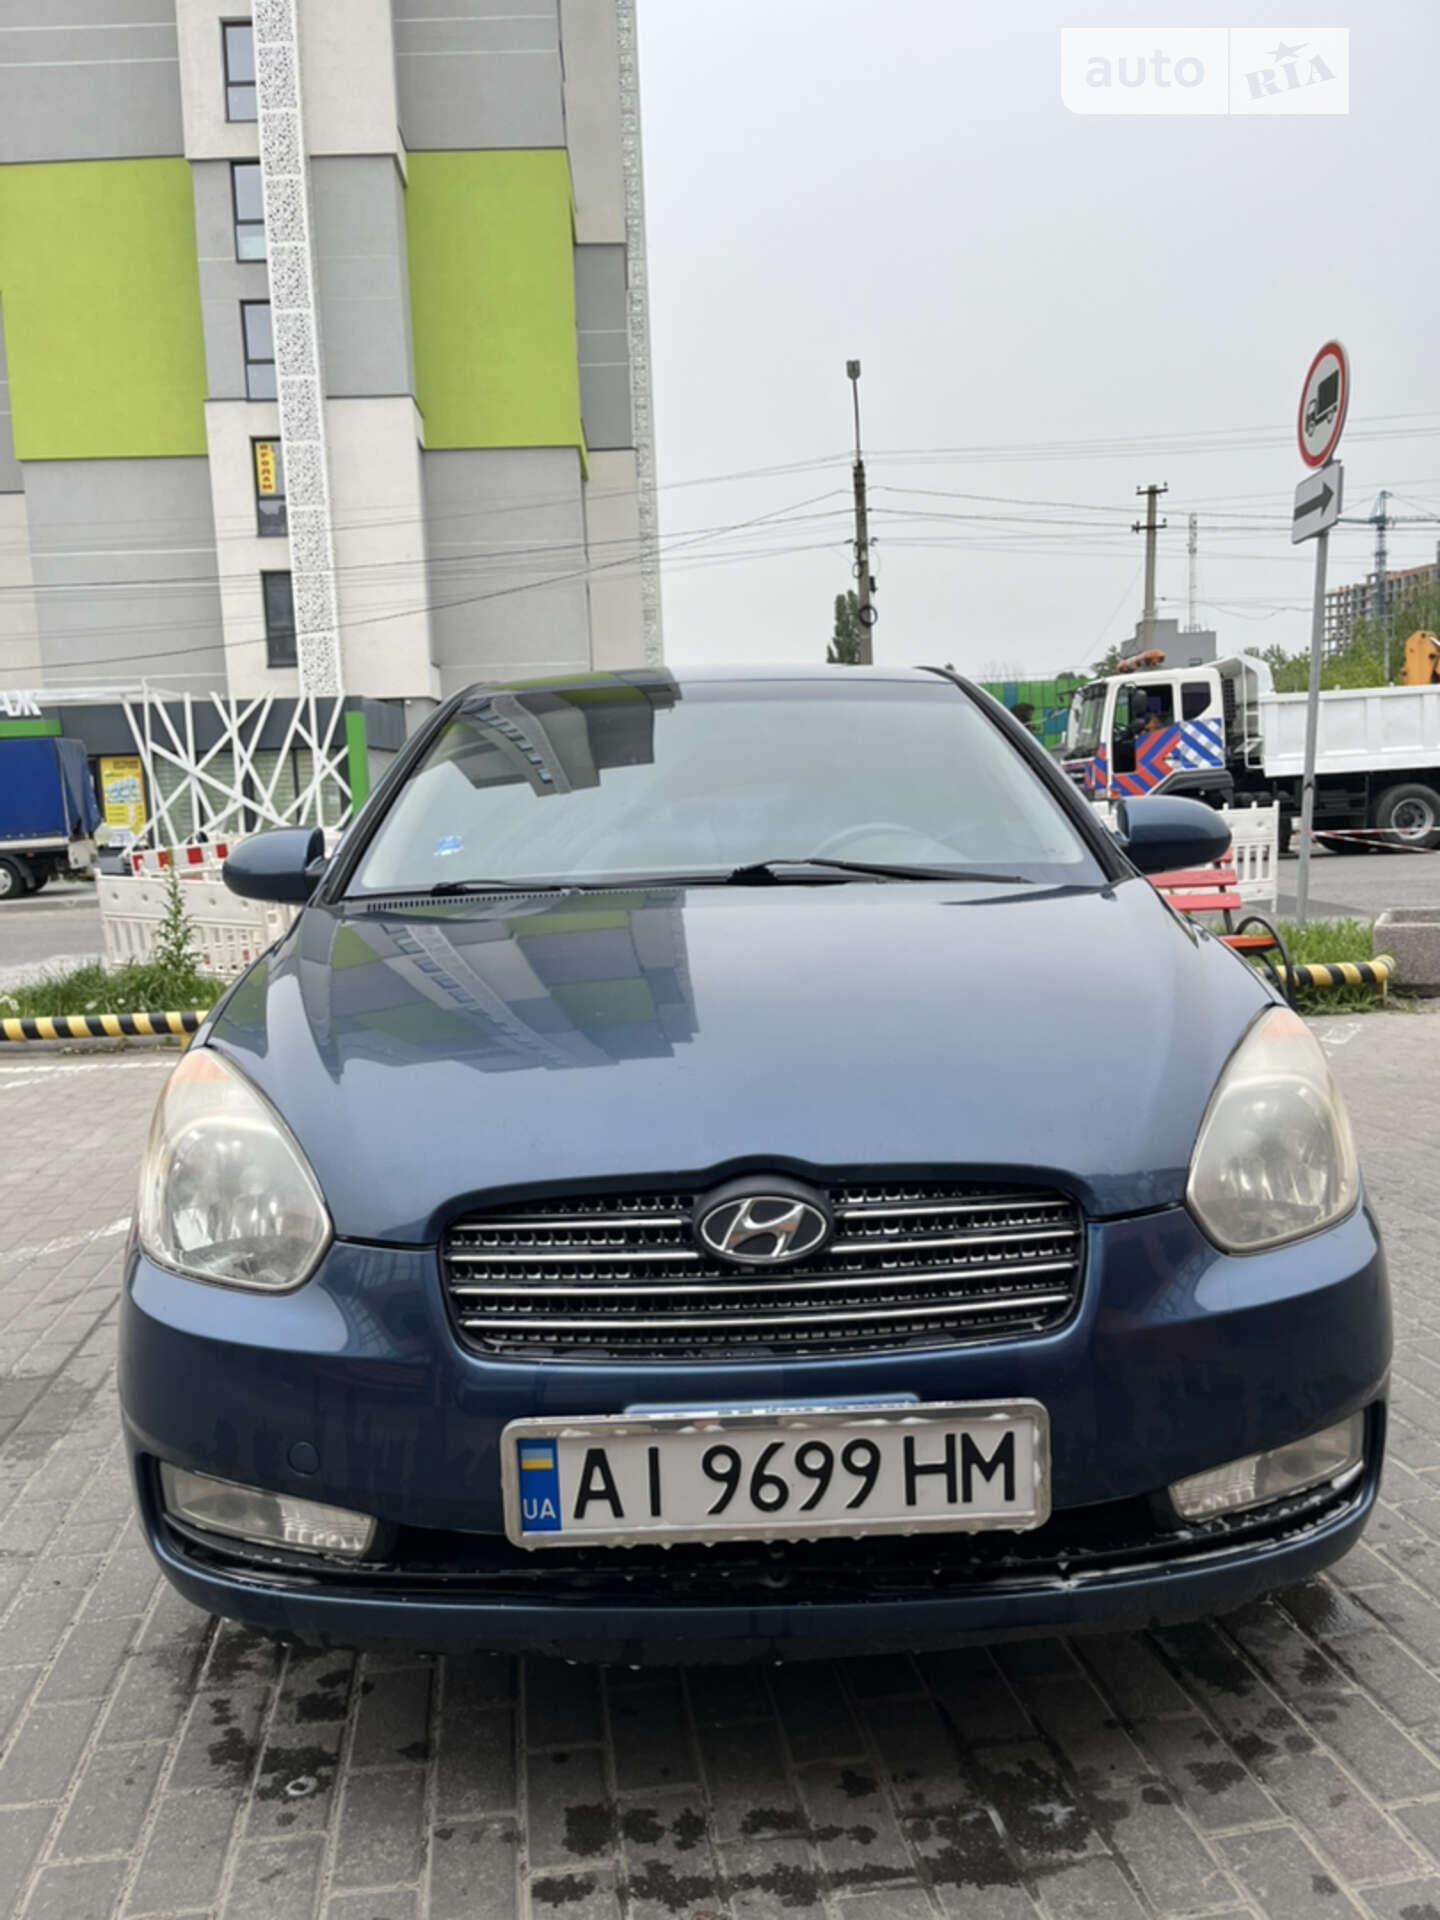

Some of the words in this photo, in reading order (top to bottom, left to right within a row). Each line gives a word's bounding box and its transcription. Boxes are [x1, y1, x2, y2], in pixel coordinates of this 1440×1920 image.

[573, 1446, 661, 1519] AI
[702, 1438, 881, 1516] 9699
[903, 1431, 1015, 1506] HM
[523, 1497, 556, 1520] UA
